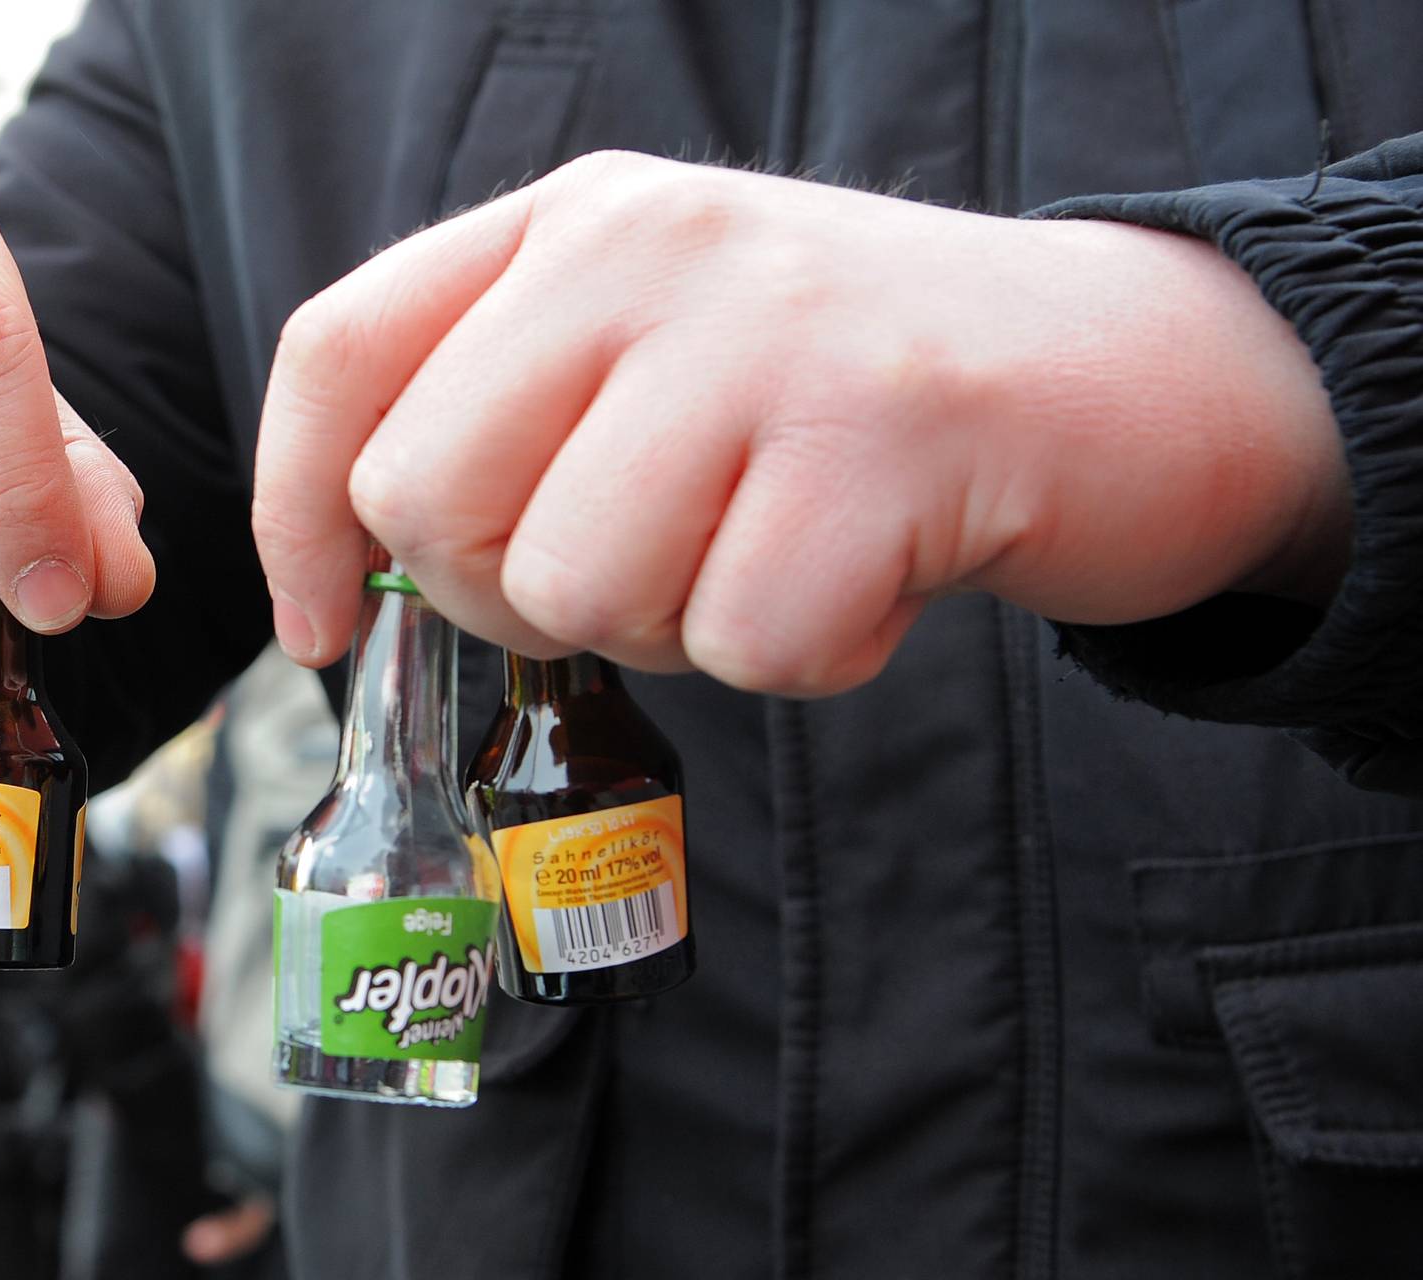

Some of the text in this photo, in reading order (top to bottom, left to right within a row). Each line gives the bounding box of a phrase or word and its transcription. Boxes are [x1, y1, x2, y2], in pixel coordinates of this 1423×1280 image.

[532, 829, 661, 865] Sahnelikör
[607, 854, 641, 877] 17%
[642, 846, 662, 867] vol
[403, 908, 453, 936] Feige
[567, 933, 661, 965] 4204 6271
[338, 938, 494, 1035] Klopfer
